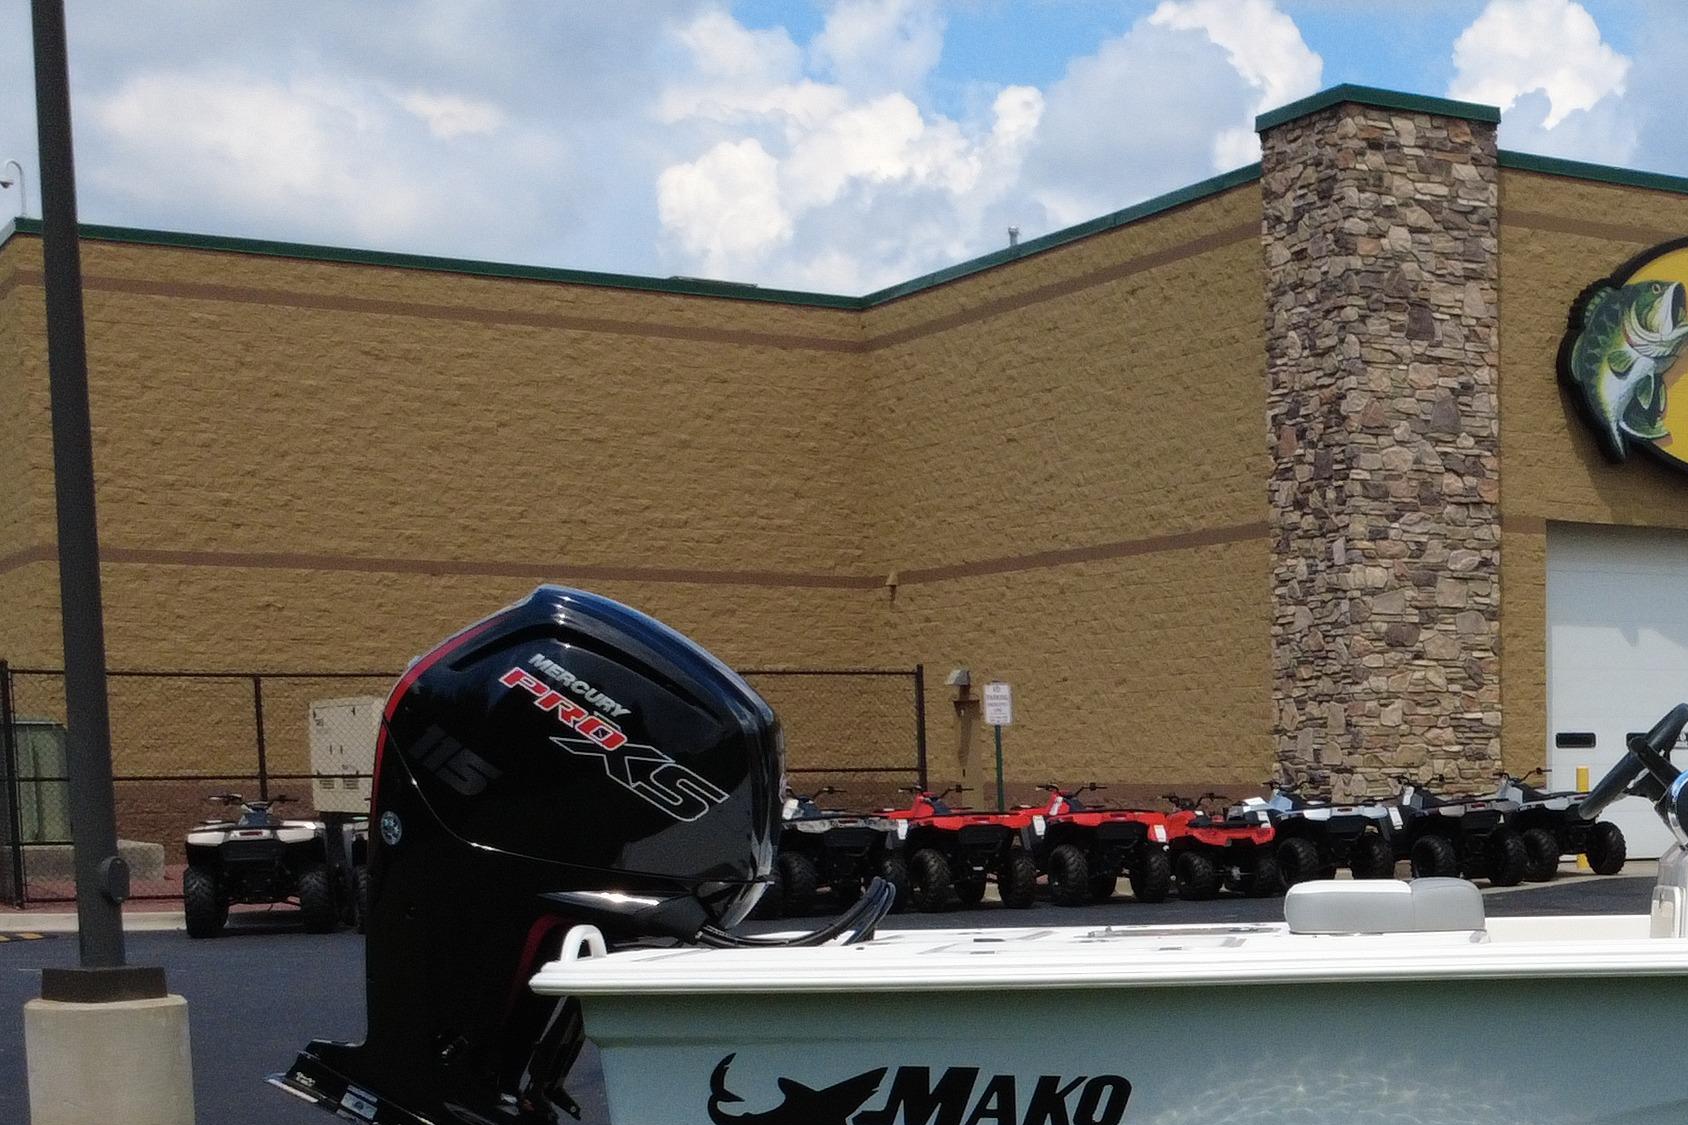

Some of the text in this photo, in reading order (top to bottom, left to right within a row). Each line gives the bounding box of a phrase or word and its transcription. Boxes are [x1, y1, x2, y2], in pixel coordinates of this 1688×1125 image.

[527, 653, 632, 718] MERCURY
[411, 723, 501, 796] 115
[498, 666, 730, 822] PRO XS
